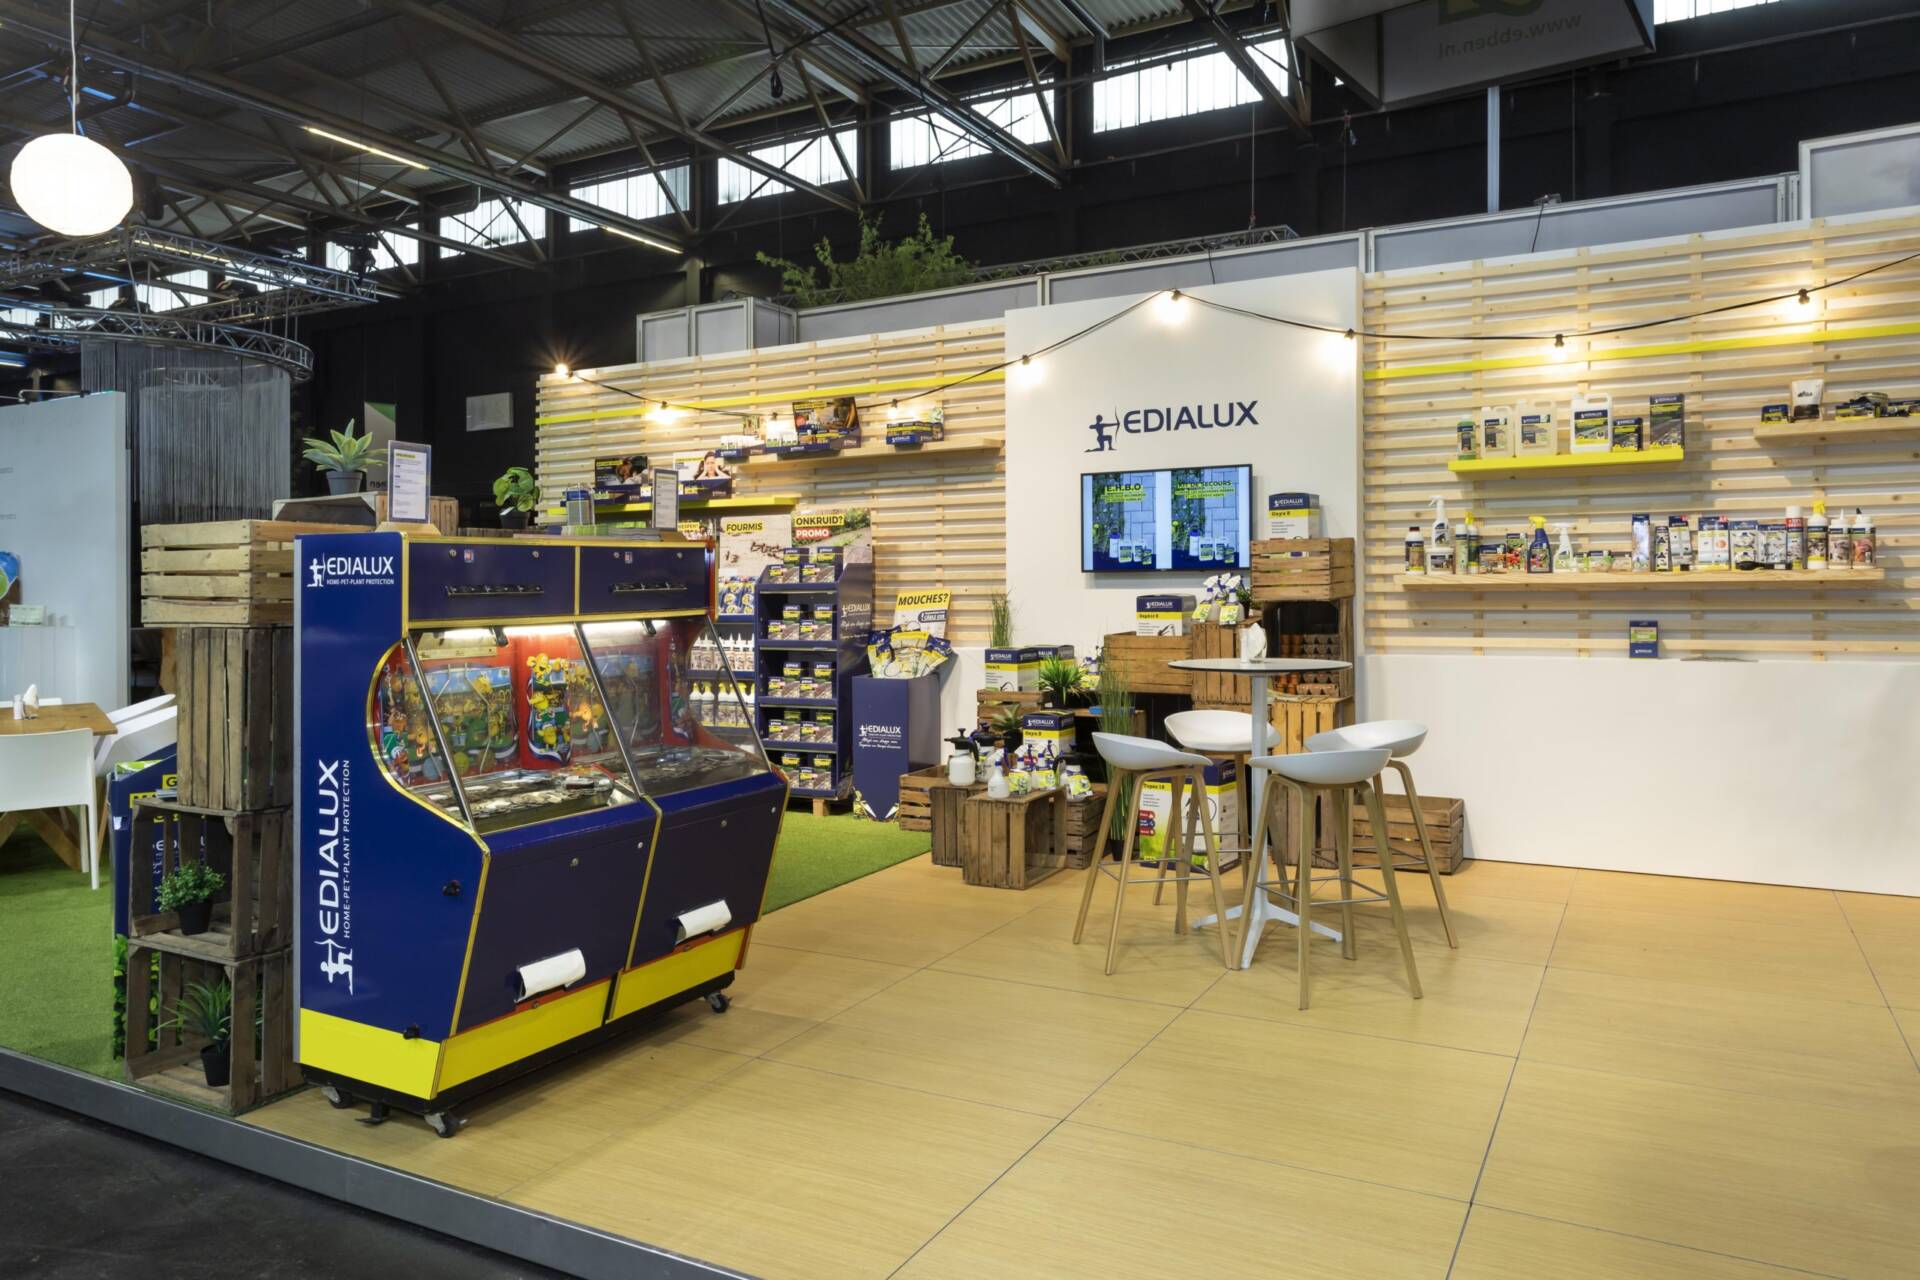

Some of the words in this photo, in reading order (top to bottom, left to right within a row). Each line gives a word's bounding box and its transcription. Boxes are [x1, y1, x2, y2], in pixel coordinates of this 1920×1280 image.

[1123, 400, 1259, 434] EDIALUX
[1106, 482, 1142, 493] E.H.B.O
[1201, 480, 1232, 488] SECOURS
[795, 515, 844, 526] ONKRUID?
[726, 522, 763, 532] FOURMIS
[795, 528, 830, 538] PROMO
[327, 556, 394, 575] EDIALUX
[897, 593, 949, 606] MOUCHES?
[848, 603, 871, 612] EDIALUX
[868, 725, 901, 734] EDIALUX
[342, 759, 350, 833] PROTECTION
[318, 759, 340, 935] EDIALUX
[342, 838, 350, 939] HOME-PET-PLANT
